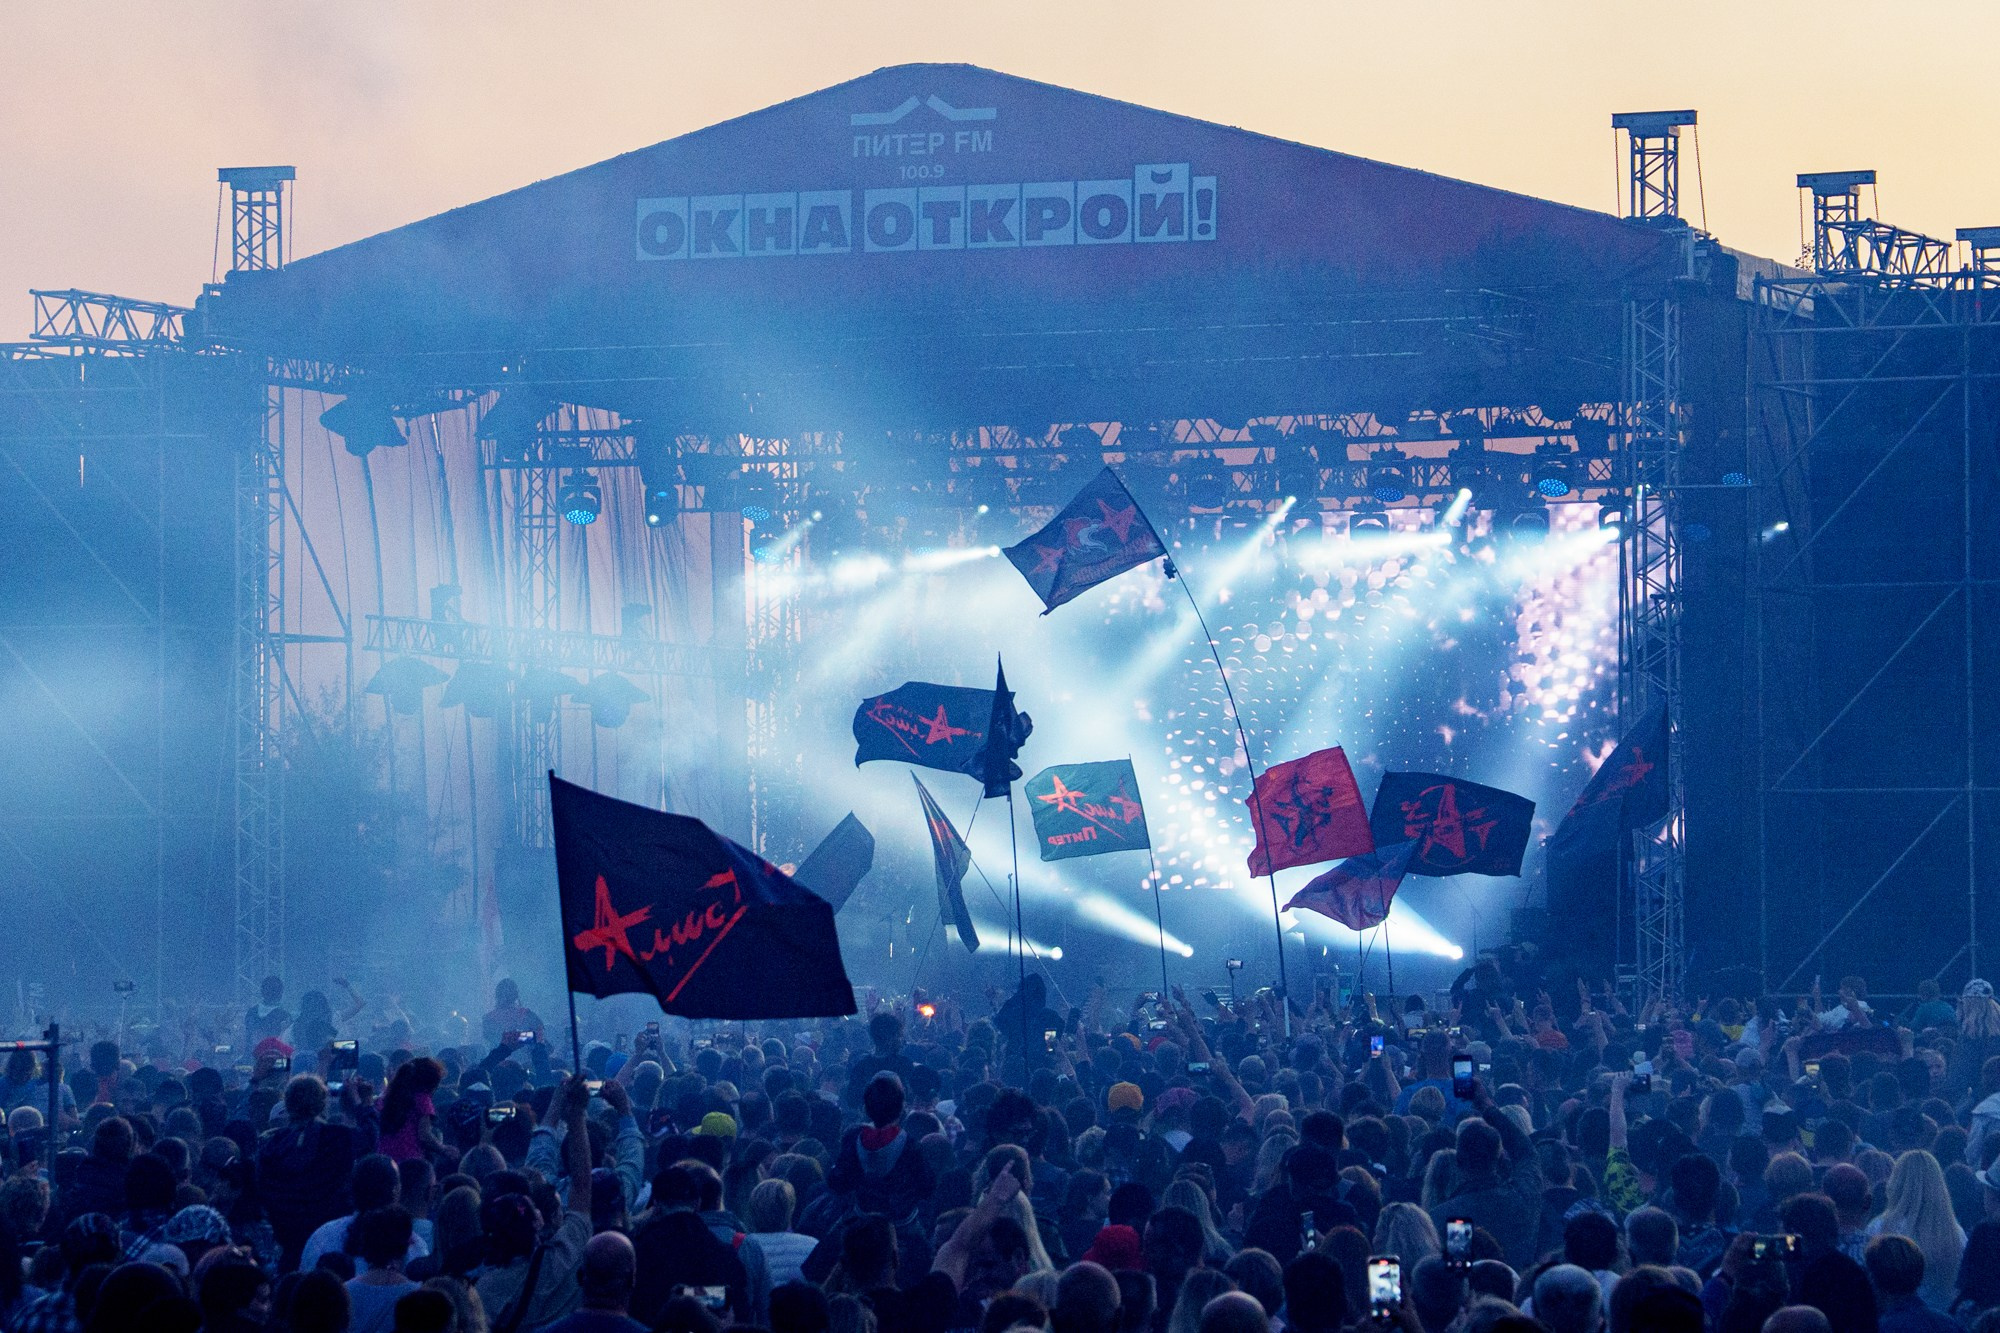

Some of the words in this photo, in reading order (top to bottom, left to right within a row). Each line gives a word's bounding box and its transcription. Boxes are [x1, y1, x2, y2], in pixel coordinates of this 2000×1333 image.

[853, 131, 945, 158] ПИТЕР
[954, 129, 993, 154] FM
[900, 164, 945, 180] 100.9
[637, 204, 851, 257] ОКНА
[866, 168, 1214, 248] ОТКРОЙ!
